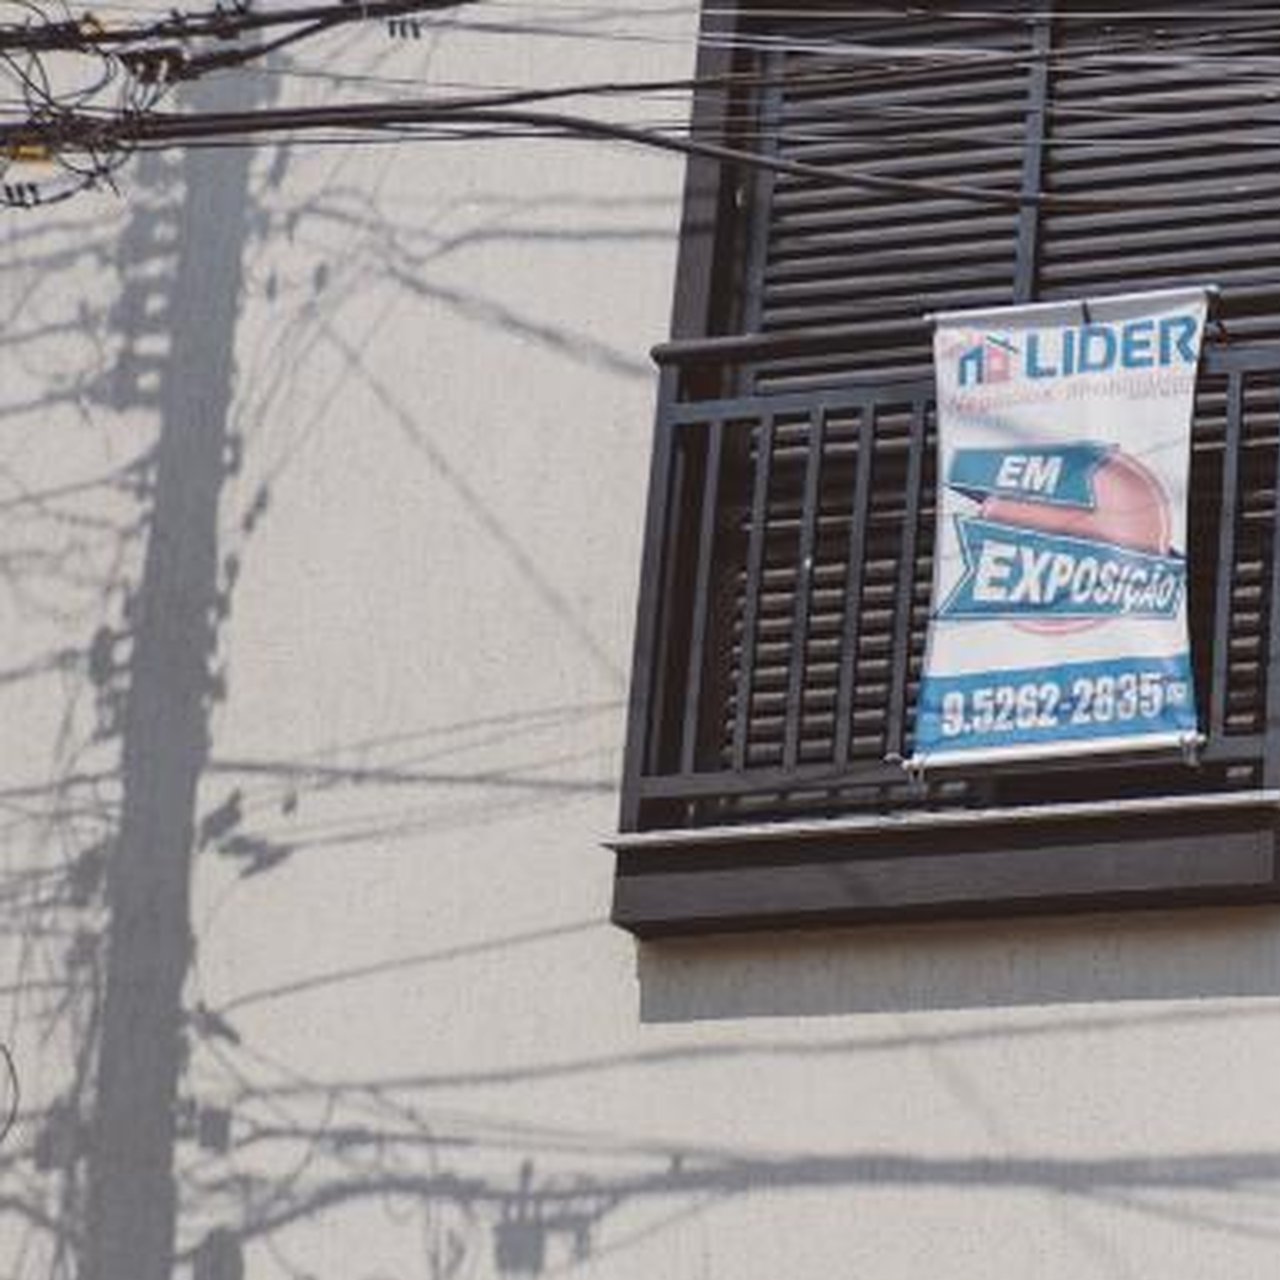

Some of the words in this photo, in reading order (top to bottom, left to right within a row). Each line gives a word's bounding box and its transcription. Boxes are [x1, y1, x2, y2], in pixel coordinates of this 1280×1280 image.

[1025, 313, 1199, 379] LIDER
[996, 455, 1062, 496] EM
[972, 543, 1174, 615] EXPOSIÇÃO
[941, 672, 1163, 737] 9.5262-2835
